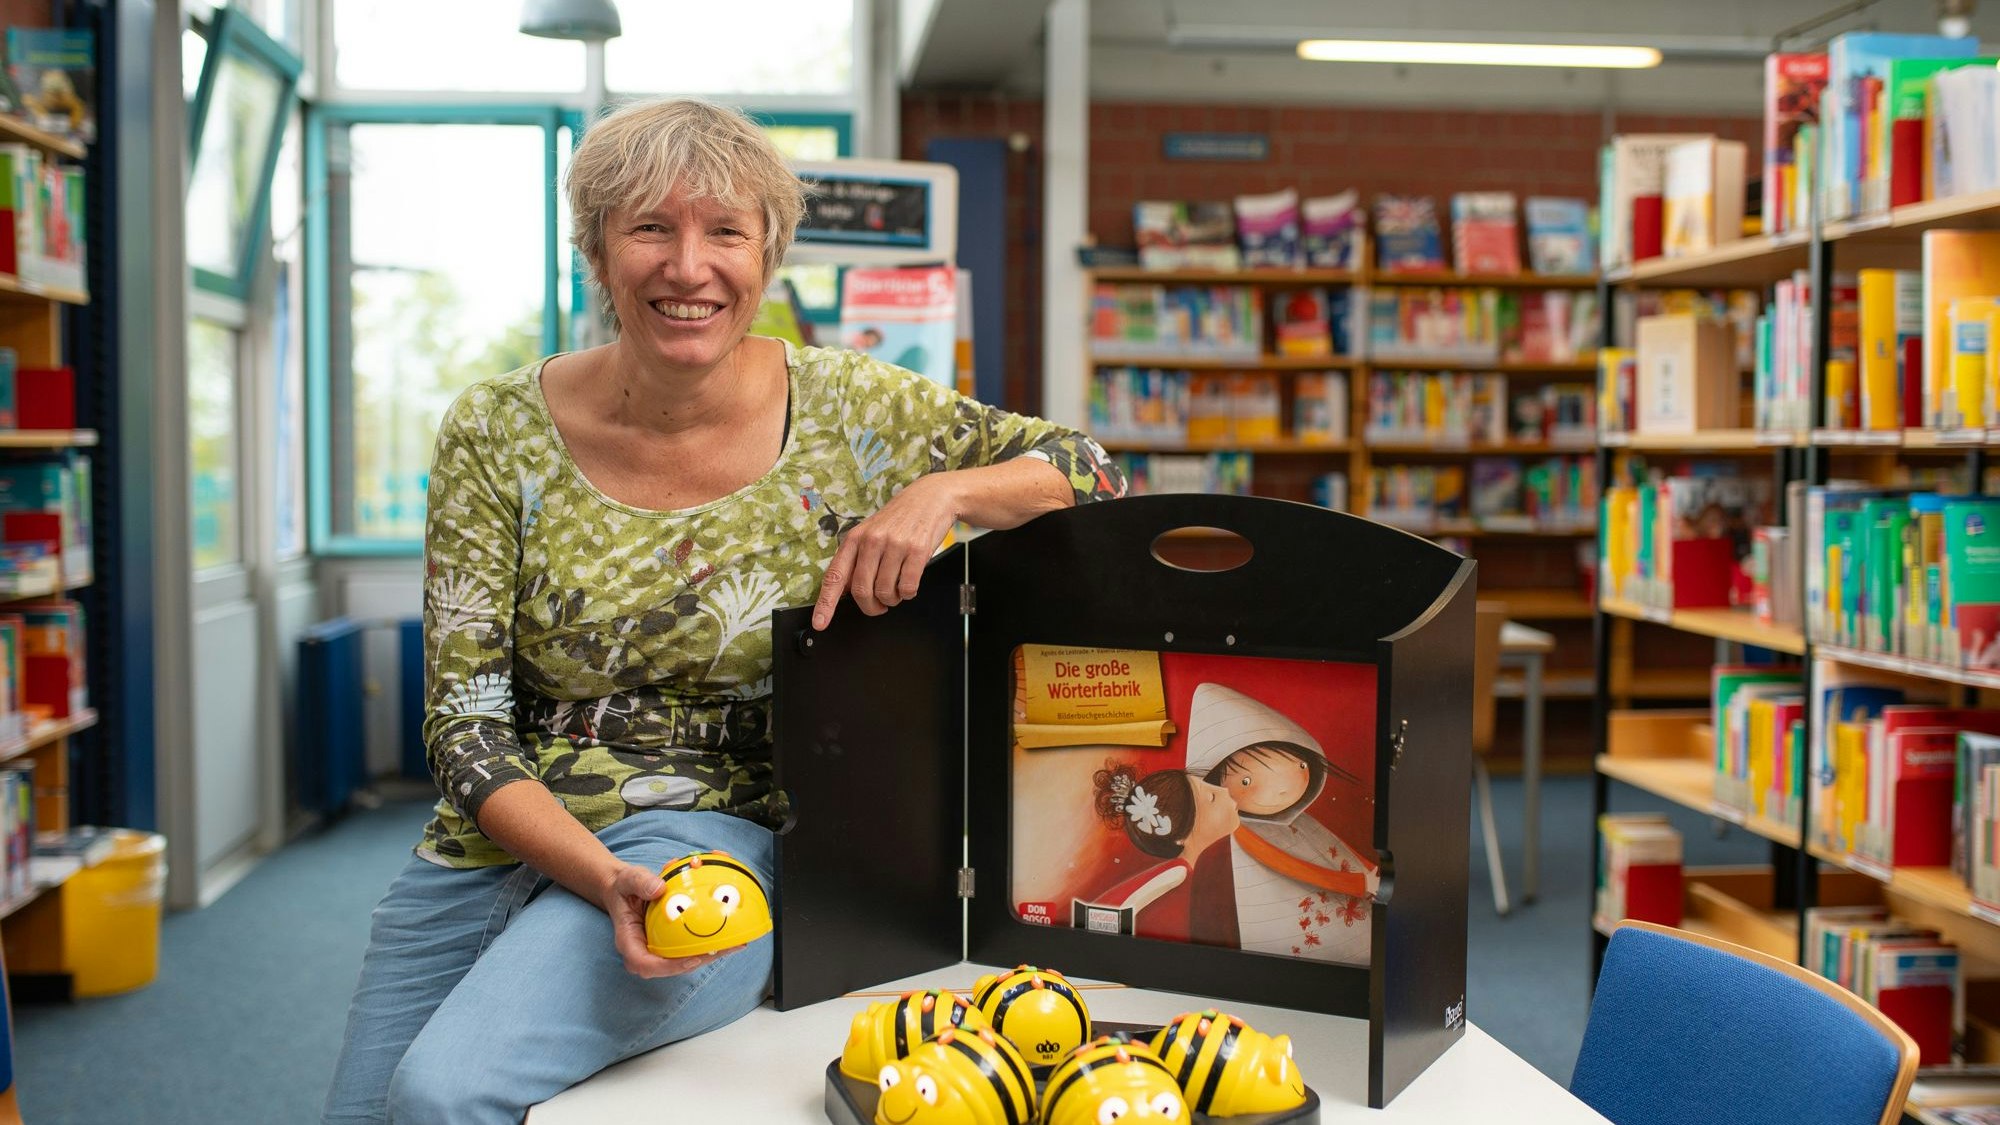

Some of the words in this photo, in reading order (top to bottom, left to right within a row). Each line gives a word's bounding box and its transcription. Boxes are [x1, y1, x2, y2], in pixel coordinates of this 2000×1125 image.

[1055, 662, 1081, 678] Die
[1085, 660, 1131, 679] große
[1047, 680, 1142, 700] Wörterfabrik
[1057, 711, 1135, 721] Bilderbuchgeschichten
[1027, 904, 1047, 915] DON
